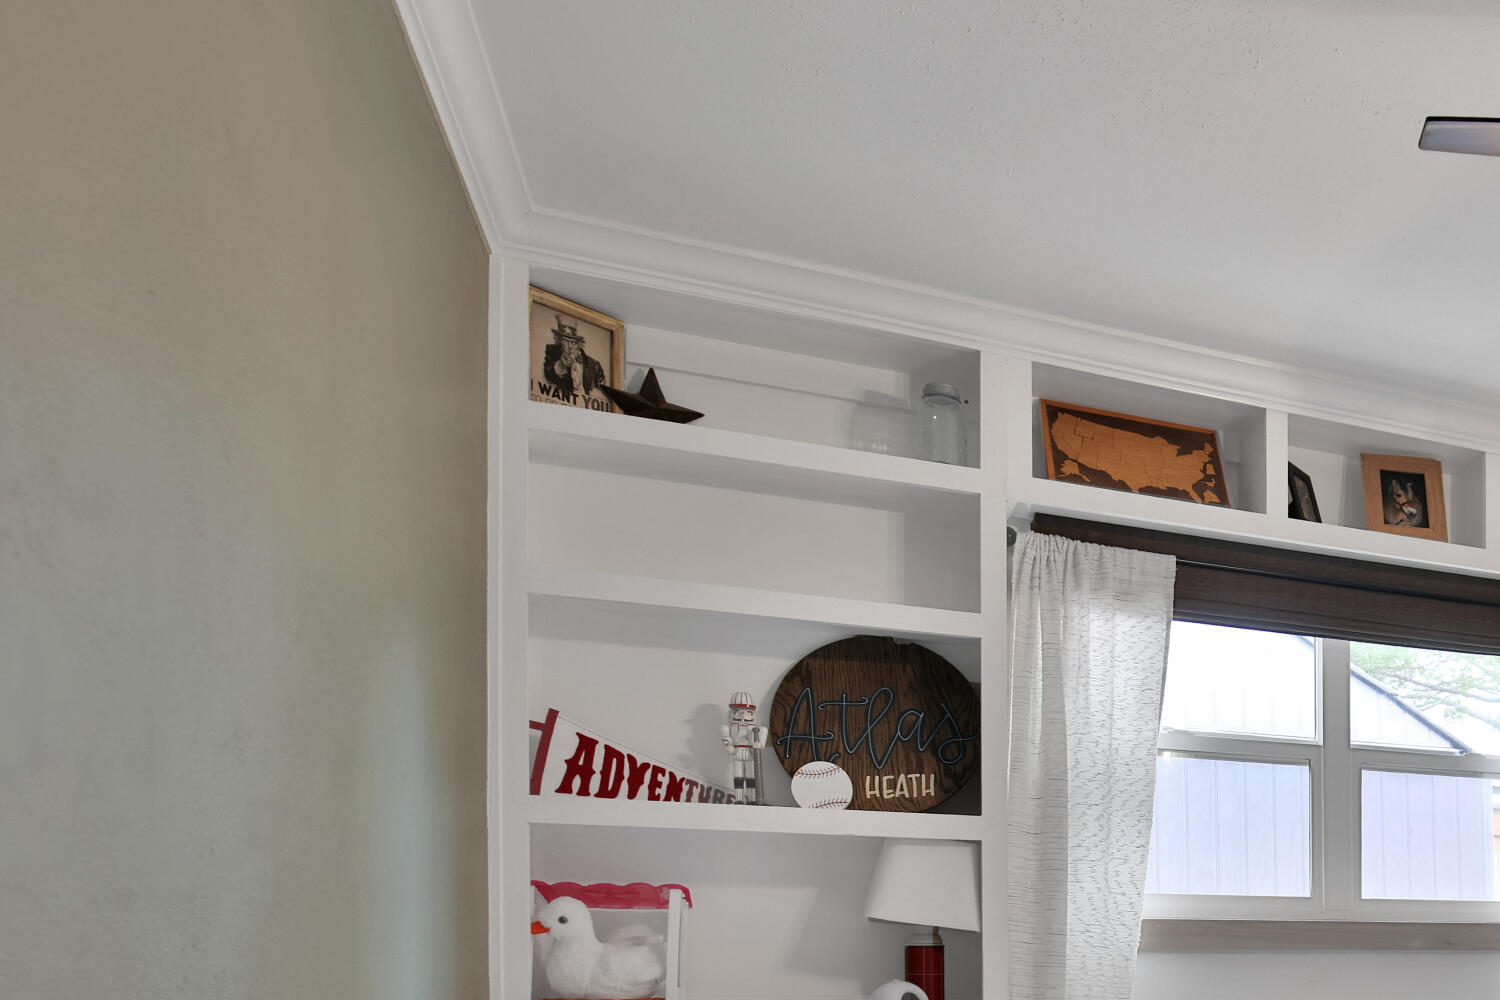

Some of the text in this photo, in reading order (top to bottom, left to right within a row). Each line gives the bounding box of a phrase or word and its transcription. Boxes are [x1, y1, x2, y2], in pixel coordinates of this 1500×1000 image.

[537, 381, 579, 406] WANT
[776, 687, 981, 770] Atlas
[865, 773, 935, 799] HEATH
